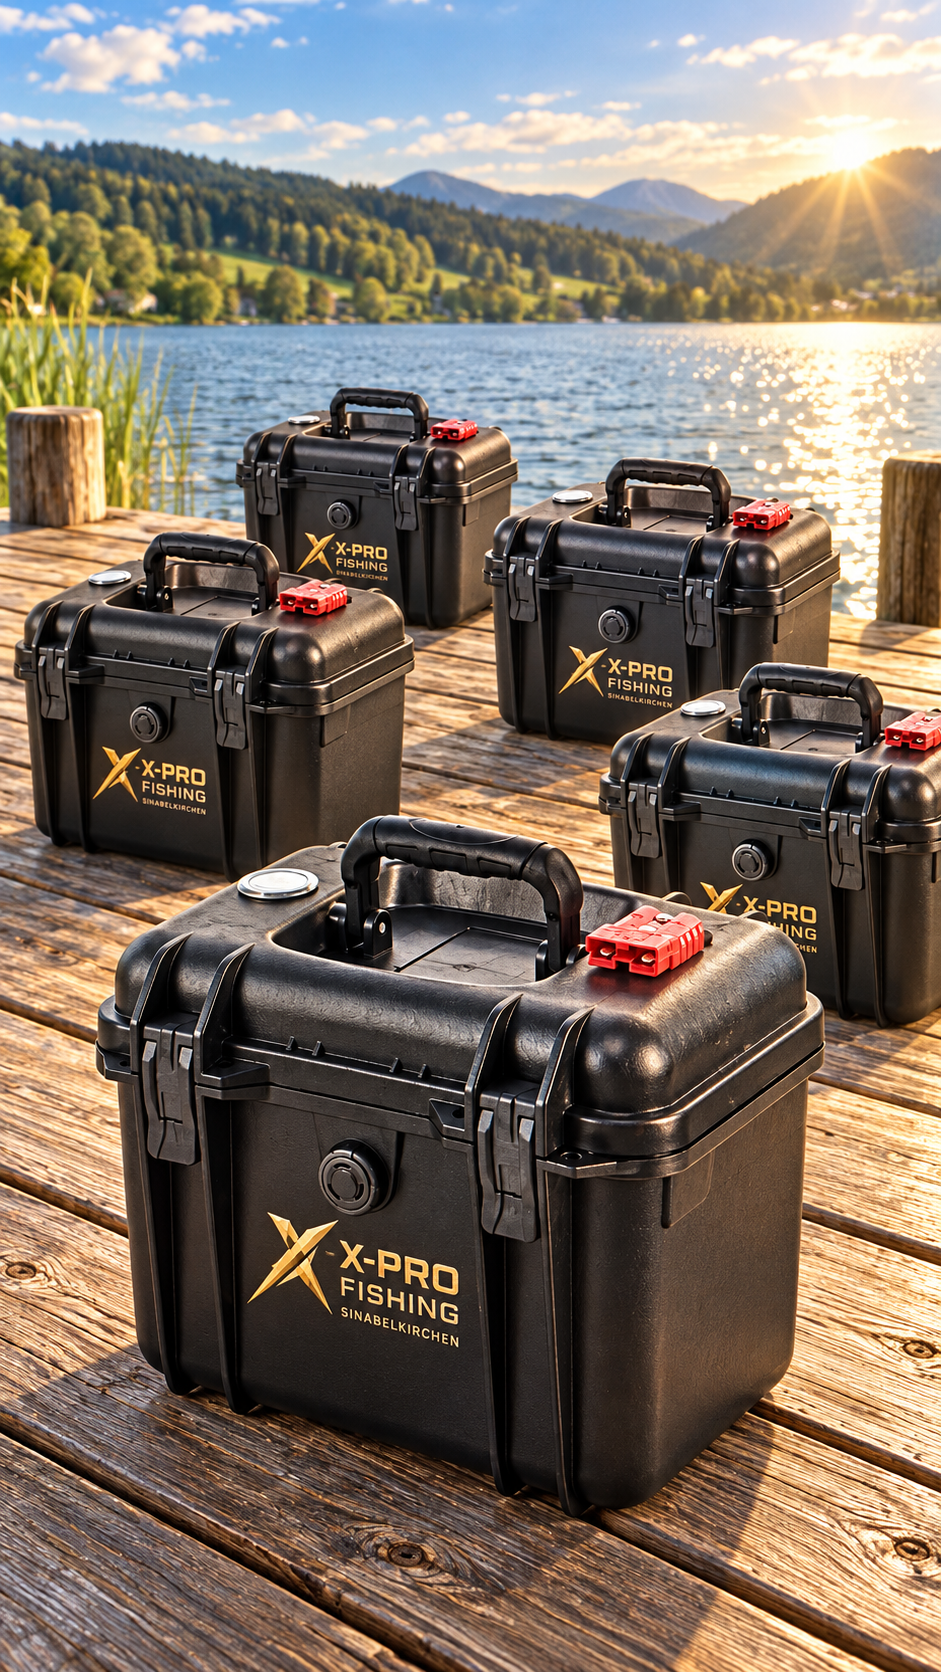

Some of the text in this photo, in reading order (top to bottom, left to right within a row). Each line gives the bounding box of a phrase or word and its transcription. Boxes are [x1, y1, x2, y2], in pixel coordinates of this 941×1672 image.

[335, 541, 388, 560] X-PRO
[336, 557, 388, 572] FISHING
[607, 657, 673, 683] X-PRO
[607, 677, 673, 697] FISHING
[141, 758, 206, 787] X-PRO
[142, 780, 206, 803] FISHING
[743, 895, 817, 924] X-PRO
[339, 1239, 459, 1296] X-PRO
[340, 1276, 459, 1325] FISHING
[340, 1306, 459, 1348] SINABELKIRCHEN
